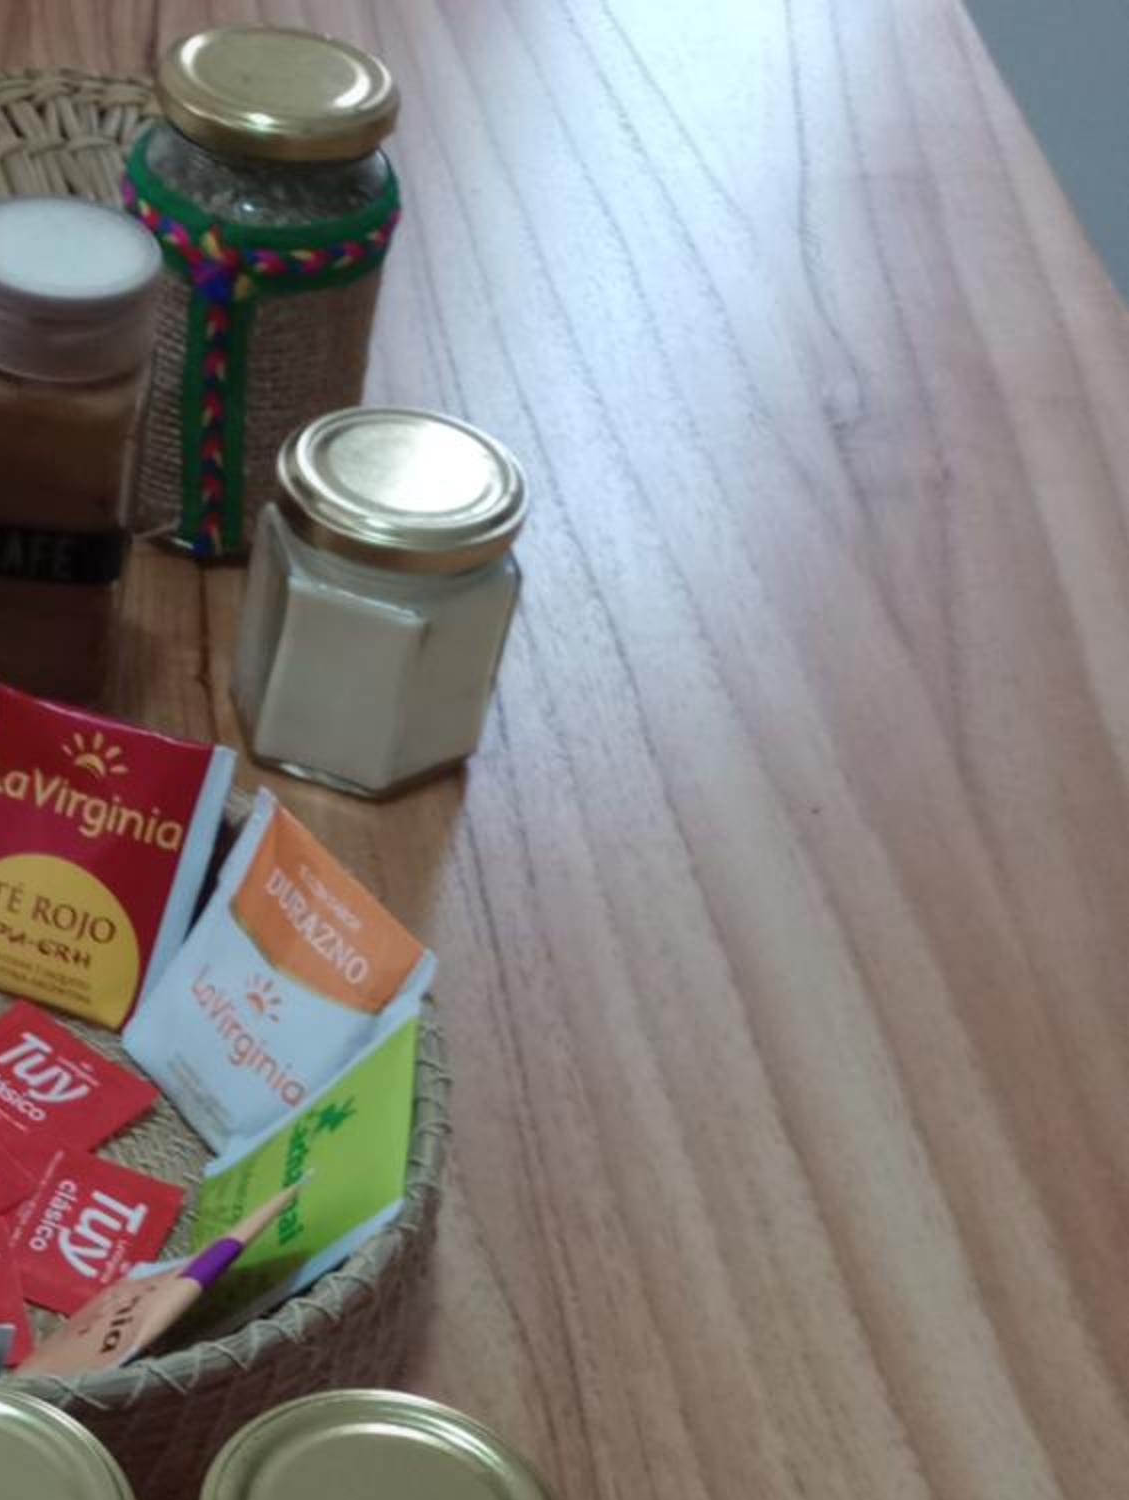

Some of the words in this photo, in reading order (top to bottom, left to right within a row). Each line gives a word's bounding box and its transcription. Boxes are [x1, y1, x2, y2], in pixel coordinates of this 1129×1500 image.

[31, 895, 117, 944] ROJO
[266, 868, 368, 985] DURAZNO
[59, 1190, 148, 1278] Tuy
